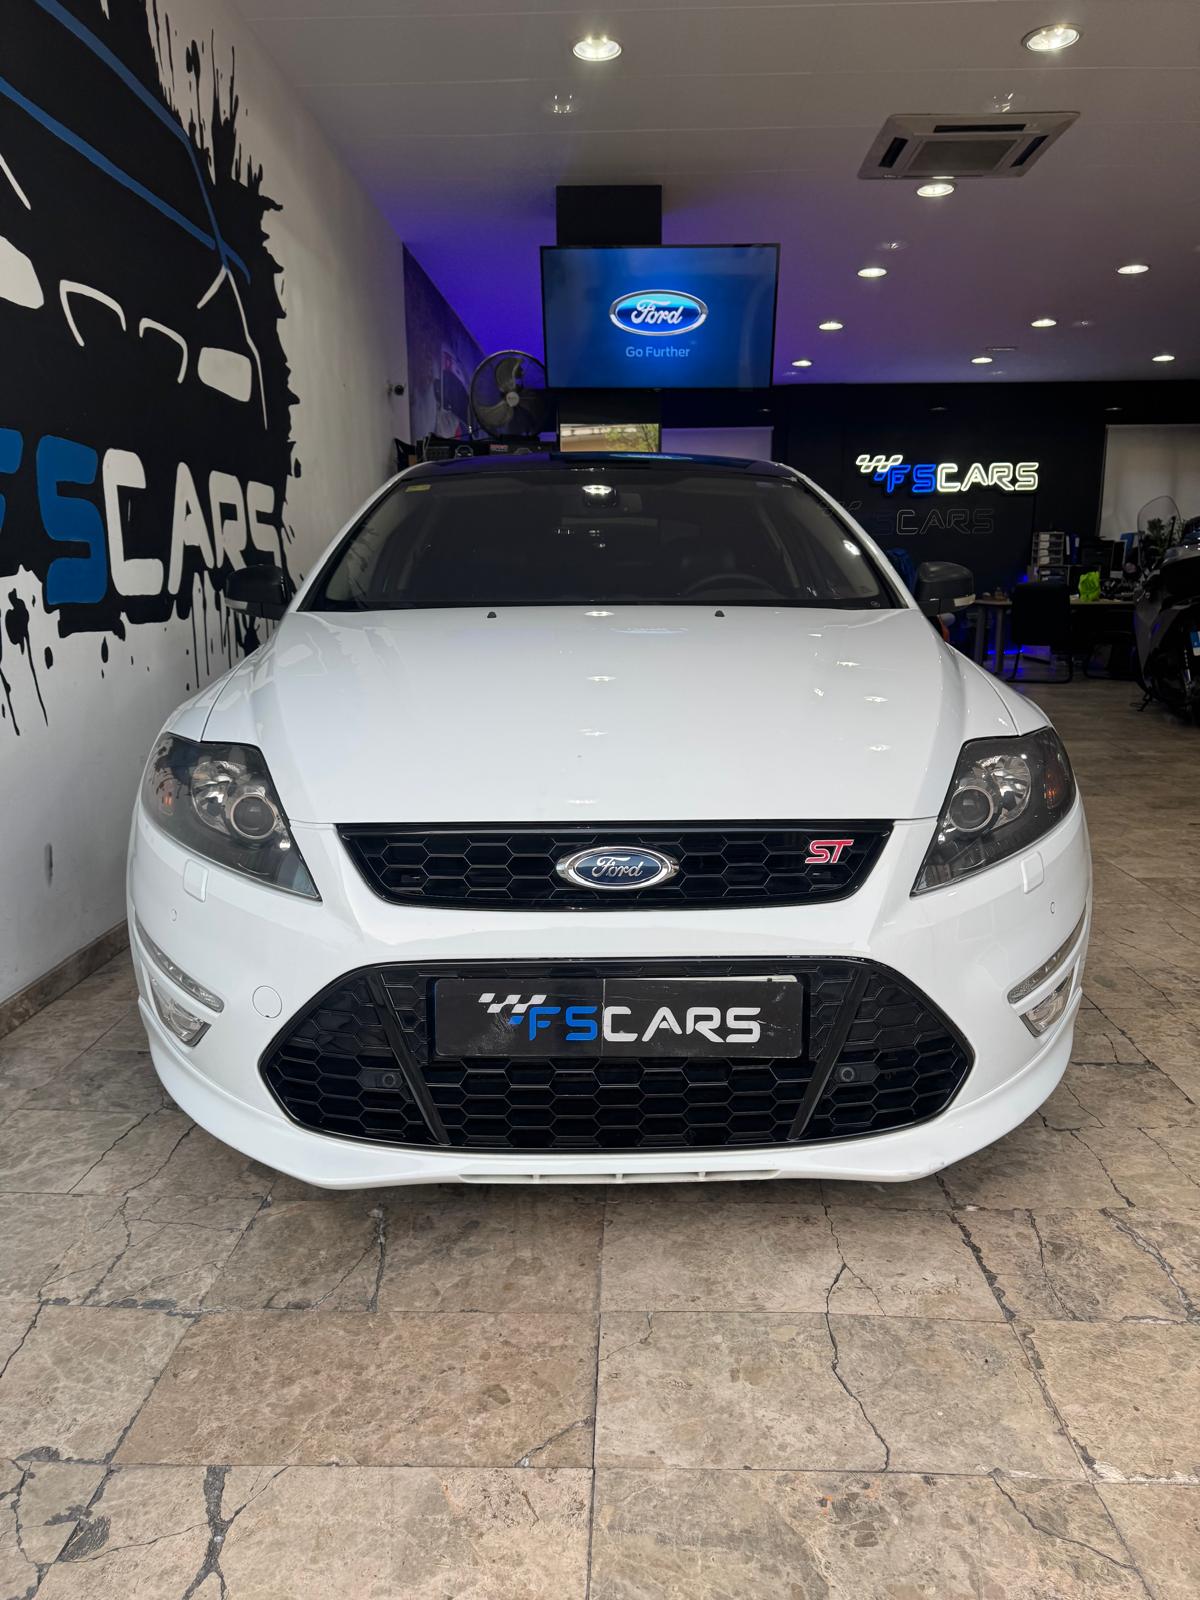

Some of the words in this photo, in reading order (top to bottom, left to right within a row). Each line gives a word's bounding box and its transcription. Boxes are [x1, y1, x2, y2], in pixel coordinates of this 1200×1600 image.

[631, 299, 683, 324] Ford
[626, 346, 643, 358] Go
[646, 346, 690, 357] Further
[805, 839, 854, 863] ST
[591, 856, 643, 877] Ford
